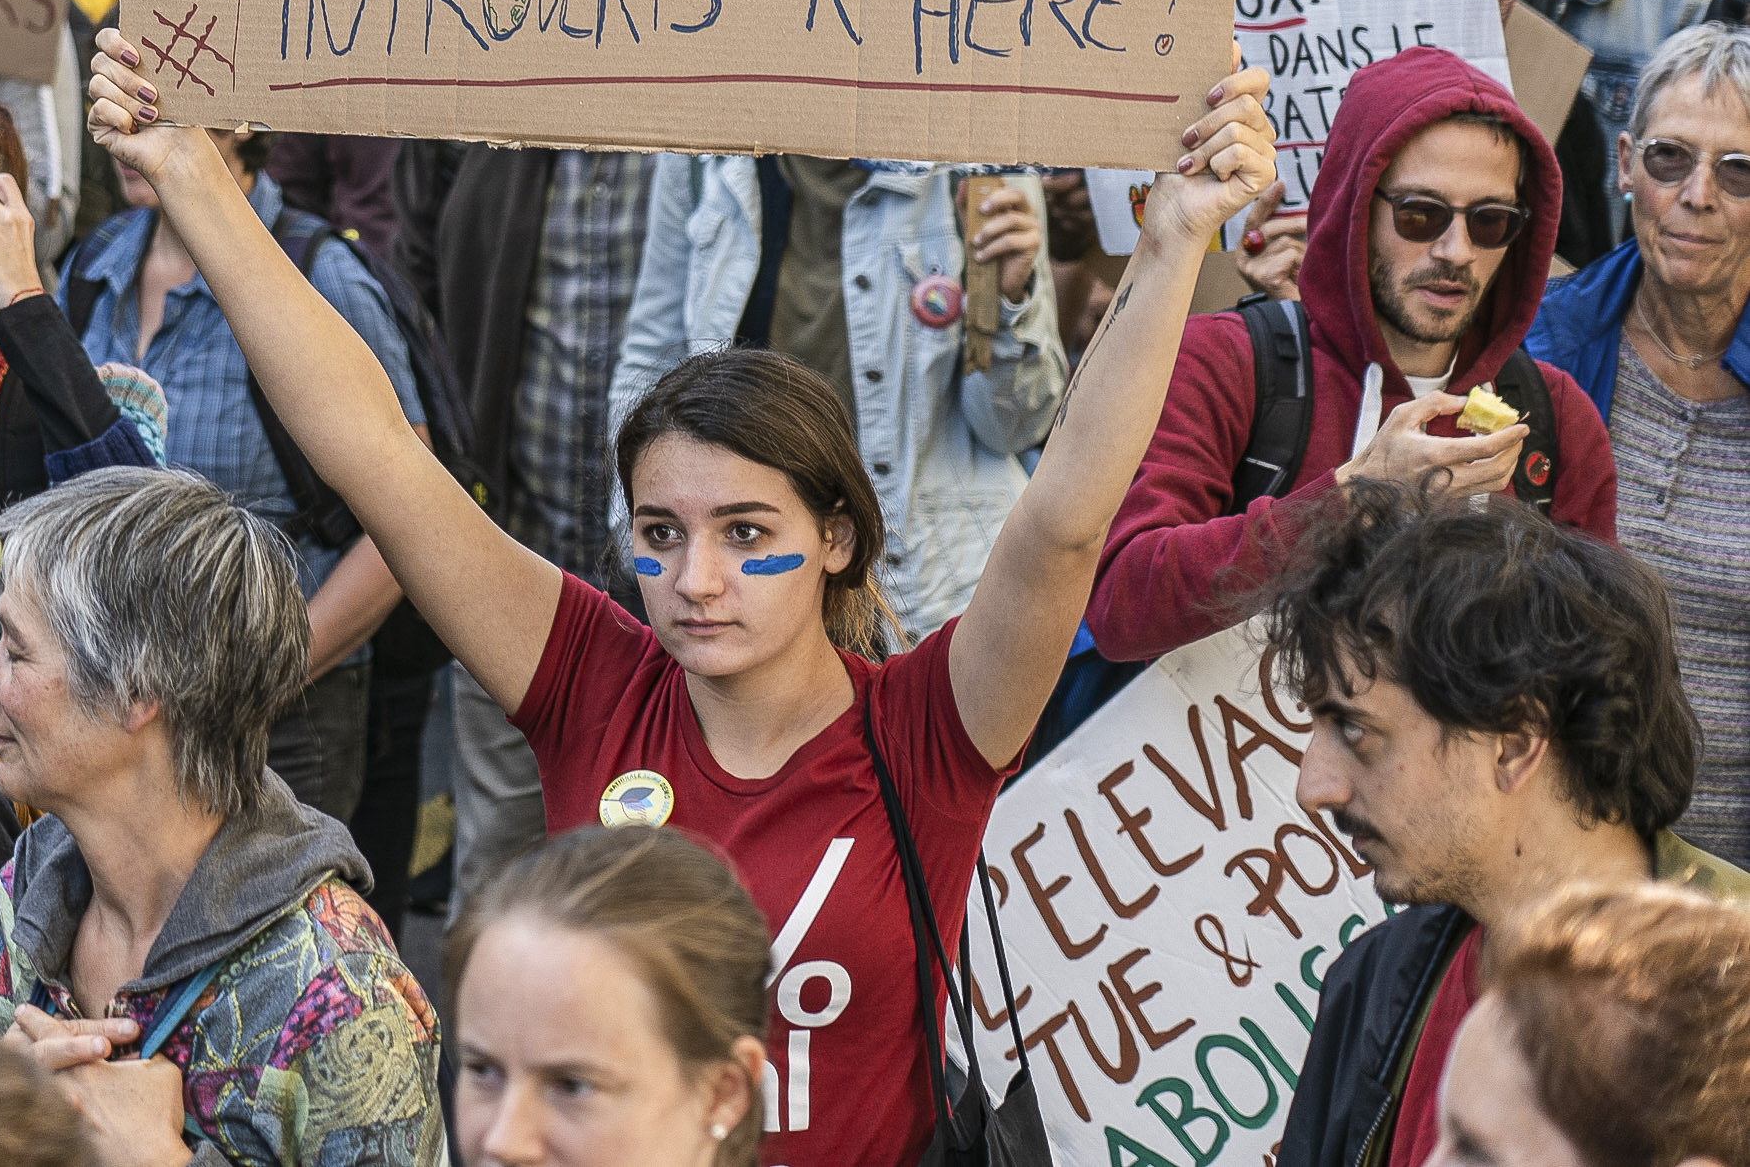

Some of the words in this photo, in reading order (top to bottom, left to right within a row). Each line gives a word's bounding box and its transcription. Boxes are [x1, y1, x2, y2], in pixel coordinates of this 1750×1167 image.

[1268, 21, 1374, 78] DANS
[1005, 946, 1197, 1124] TUE
[1194, 912, 1263, 987] &
